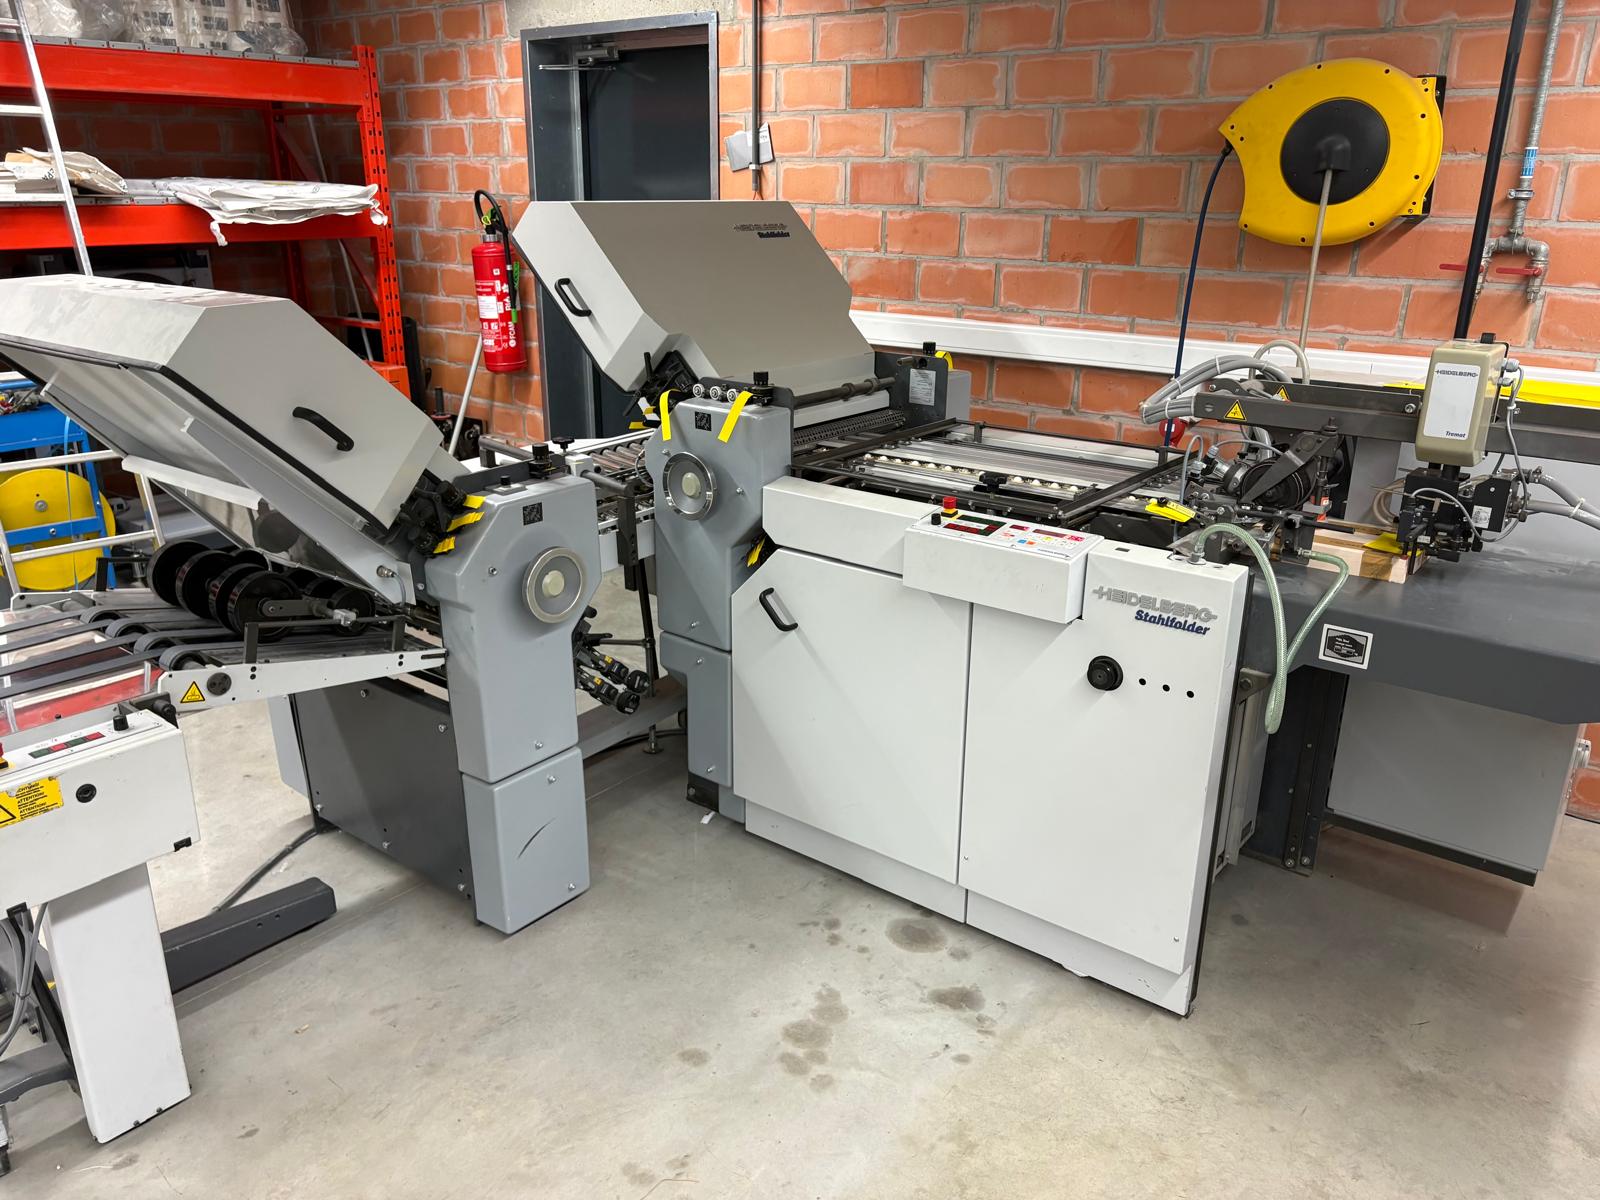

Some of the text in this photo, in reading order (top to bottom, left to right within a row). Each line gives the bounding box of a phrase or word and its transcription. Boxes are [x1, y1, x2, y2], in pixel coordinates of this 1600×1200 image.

[1435, 369, 1478, 377] HEIDELBERG
[1092, 586, 1218, 622] HEIDELBERG
[1134, 609, 1211, 635] Stahlfolder
